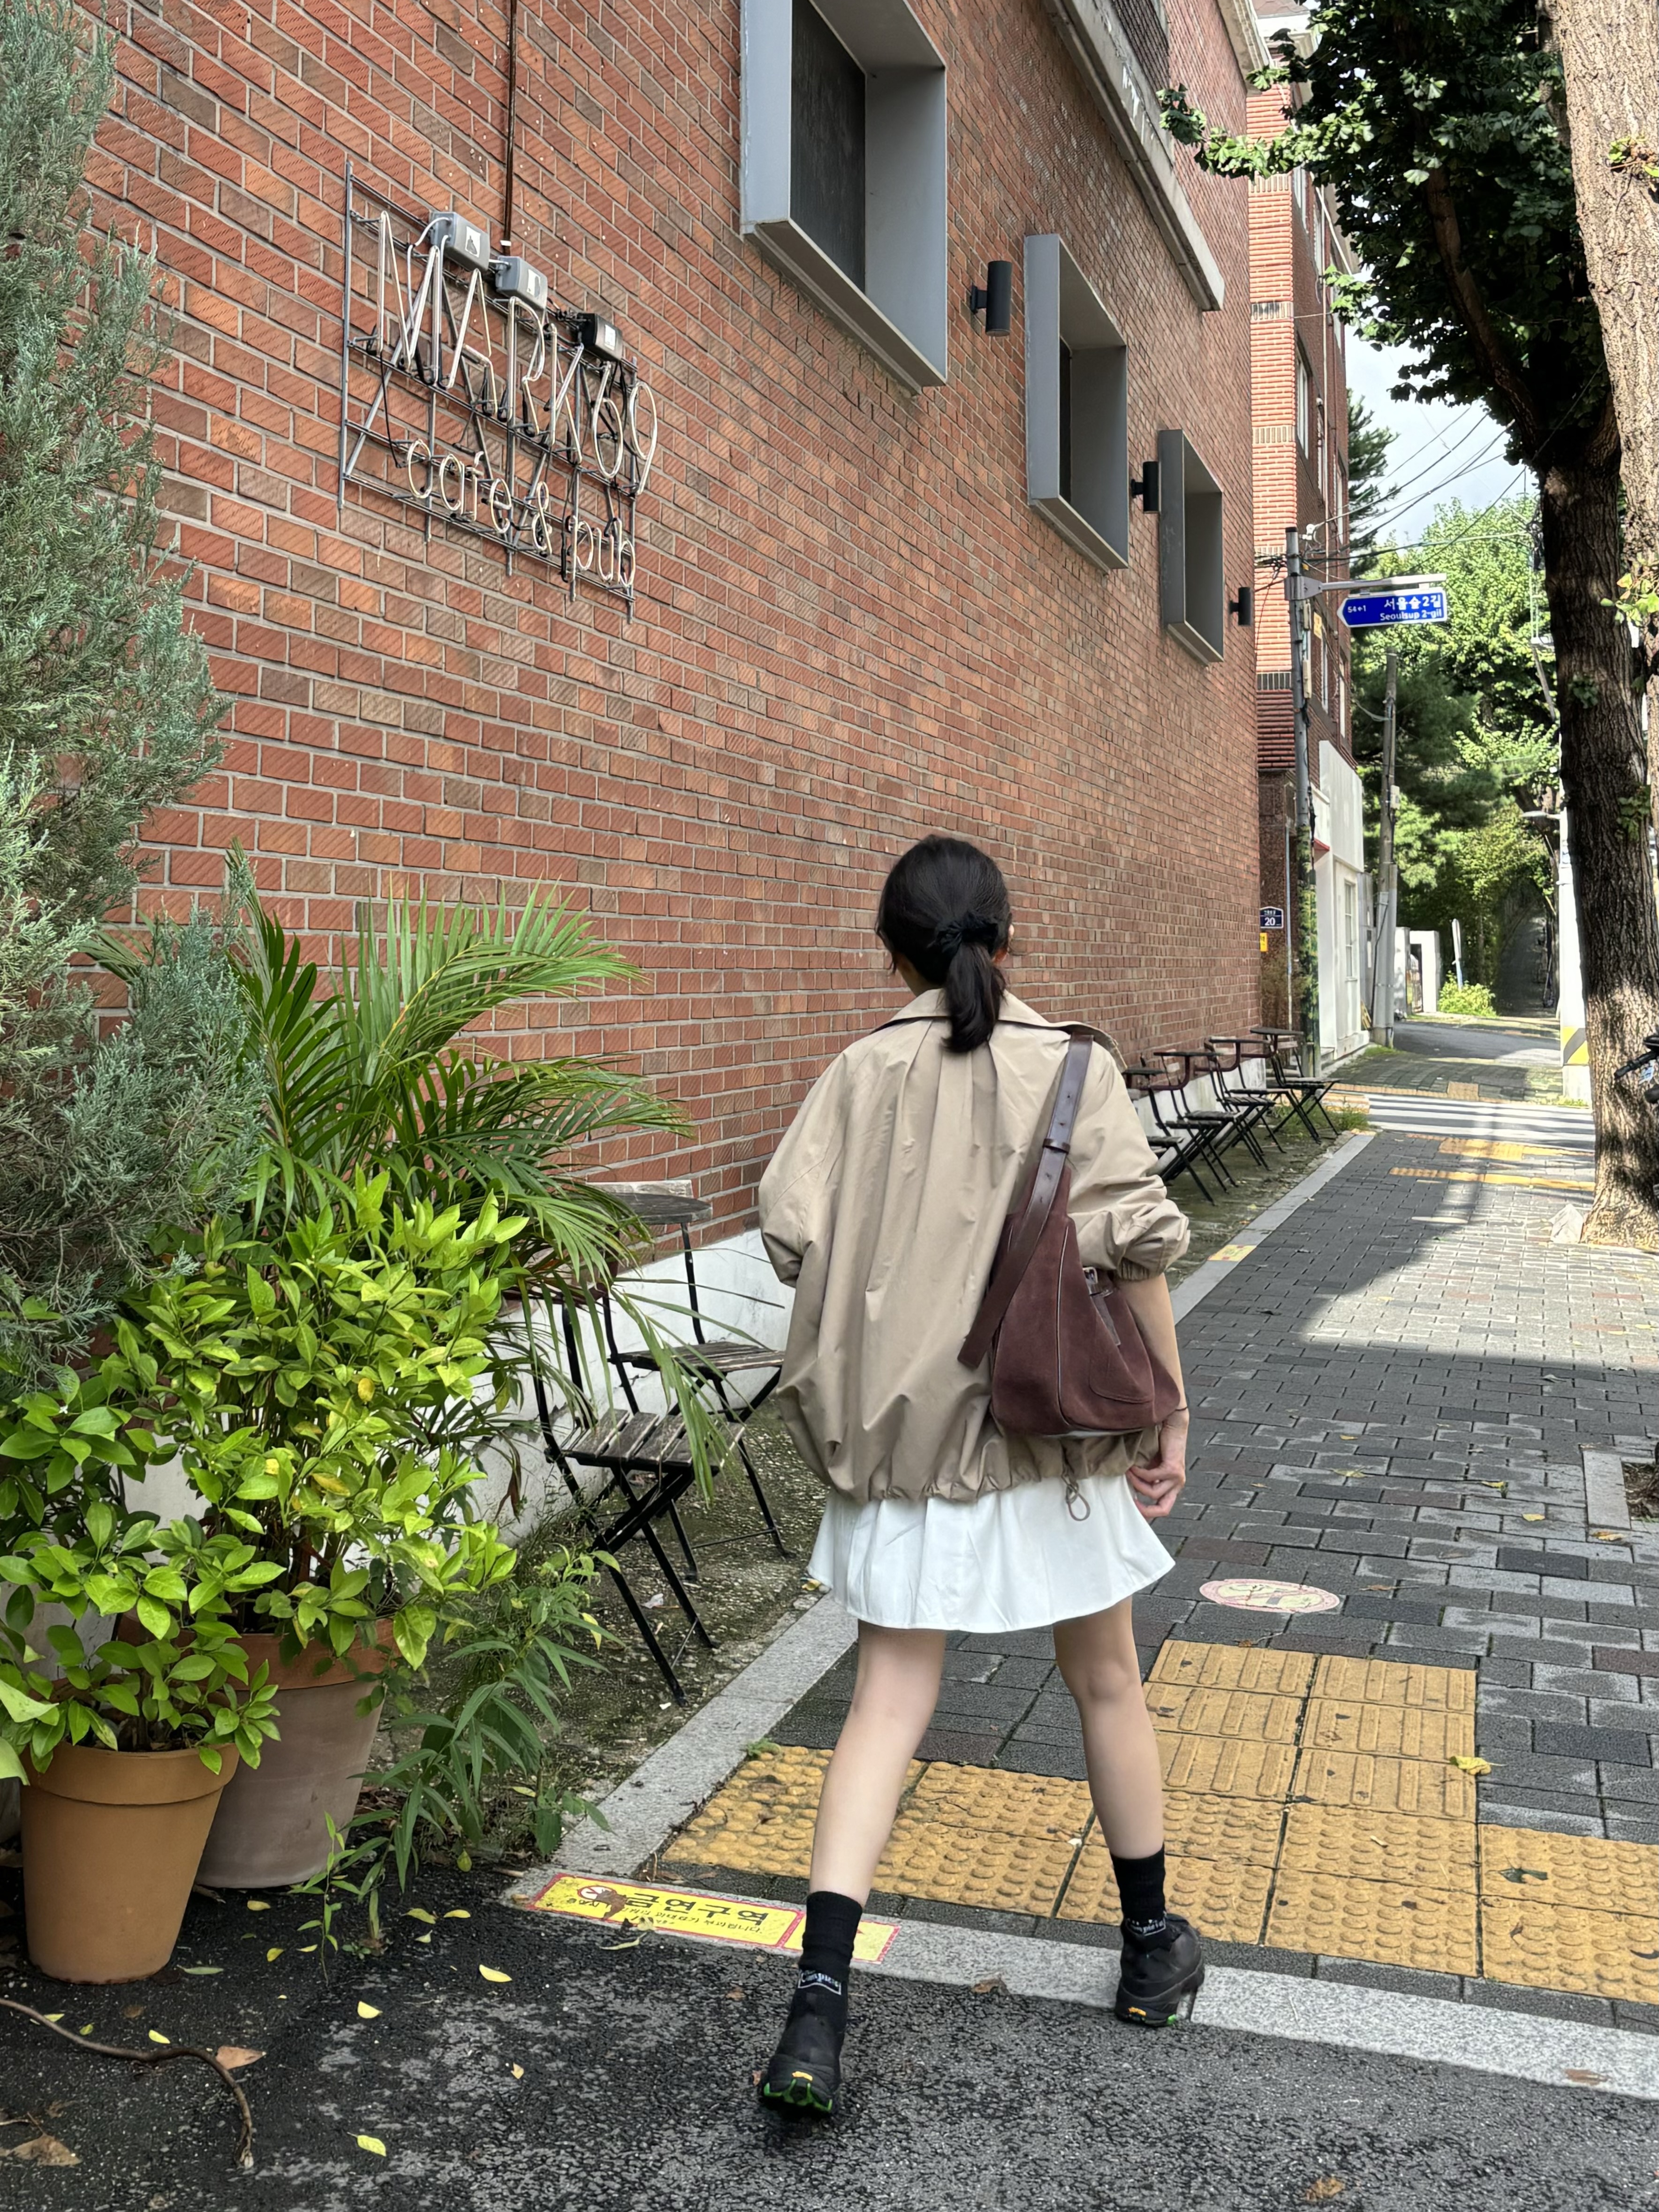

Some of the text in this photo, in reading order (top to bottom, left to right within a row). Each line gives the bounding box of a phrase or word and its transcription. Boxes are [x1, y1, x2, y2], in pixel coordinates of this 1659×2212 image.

[570, 515, 636, 587] pub
[1380, 608, 1442, 621] Seoulsup 2-gil
[1264, 917, 1276, 926] 20
[625, 1893, 769, 1925] 금연구역
